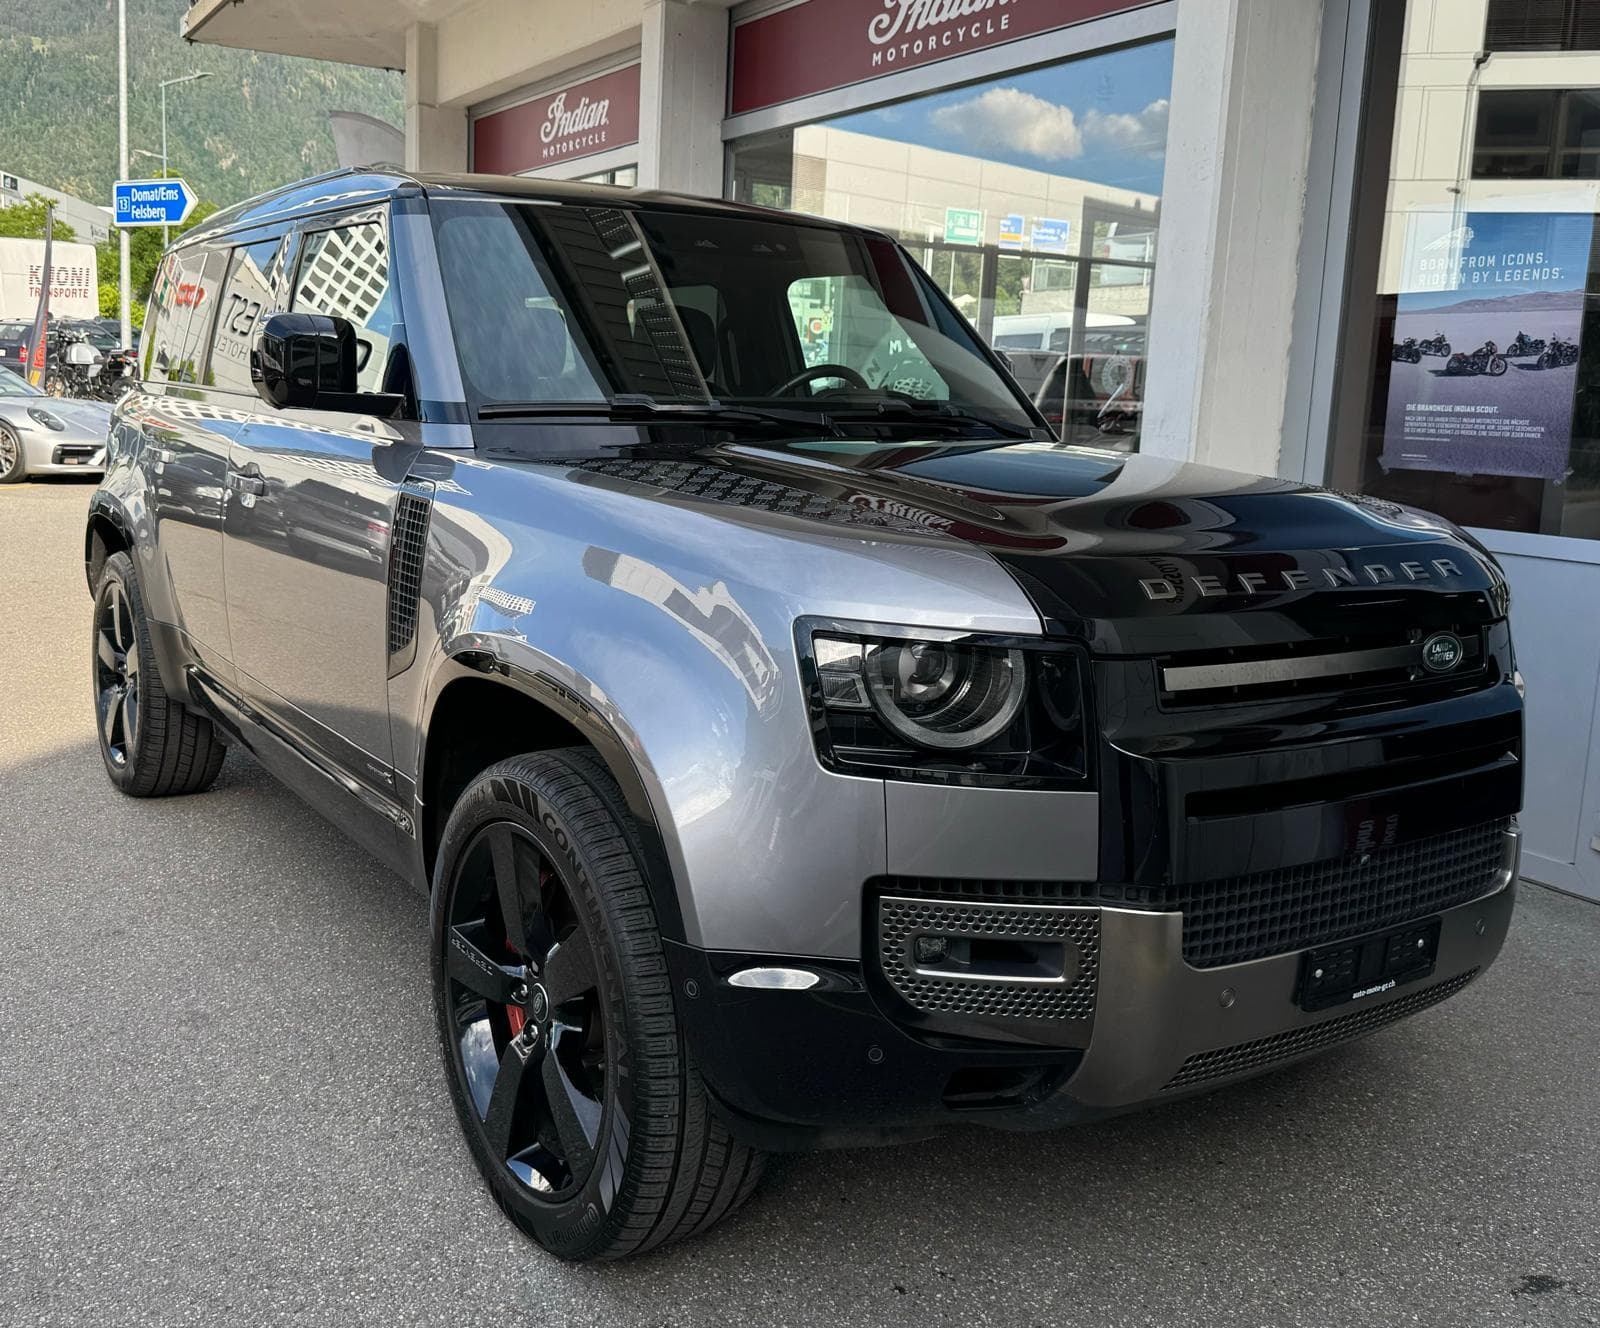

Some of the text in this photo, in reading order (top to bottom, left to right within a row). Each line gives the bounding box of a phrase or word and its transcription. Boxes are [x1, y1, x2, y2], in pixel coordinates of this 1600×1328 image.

[868, 0, 1012, 45] India
[872, 14, 1010, 67] MOTORCYCLE
[540, 92, 610, 143] Indian
[542, 131, 606, 159] MOTORCYCLE
[131, 186, 179, 202] Domat/Ems
[119, 199, 128, 210] 13
[131, 204, 166, 222] Felsberg
[1419, 252, 1549, 271] BORN FROM ICONS.
[1472, 271, 1491, 284] BY
[1495, 267, 1565, 283] LEGENDS.
[28, 287, 89, 299] TRNSPORTE
[1416, 404, 1453, 412] BRANDNEUE
[1453, 405, 1475, 413] INDIAN
[1476, 406, 1499, 414] SCOUT.
[1138, 558, 1463, 600] DEFENDER
[1431, 642, 1449, 653] LAND
[1433, 651, 1455, 662] ROVER
